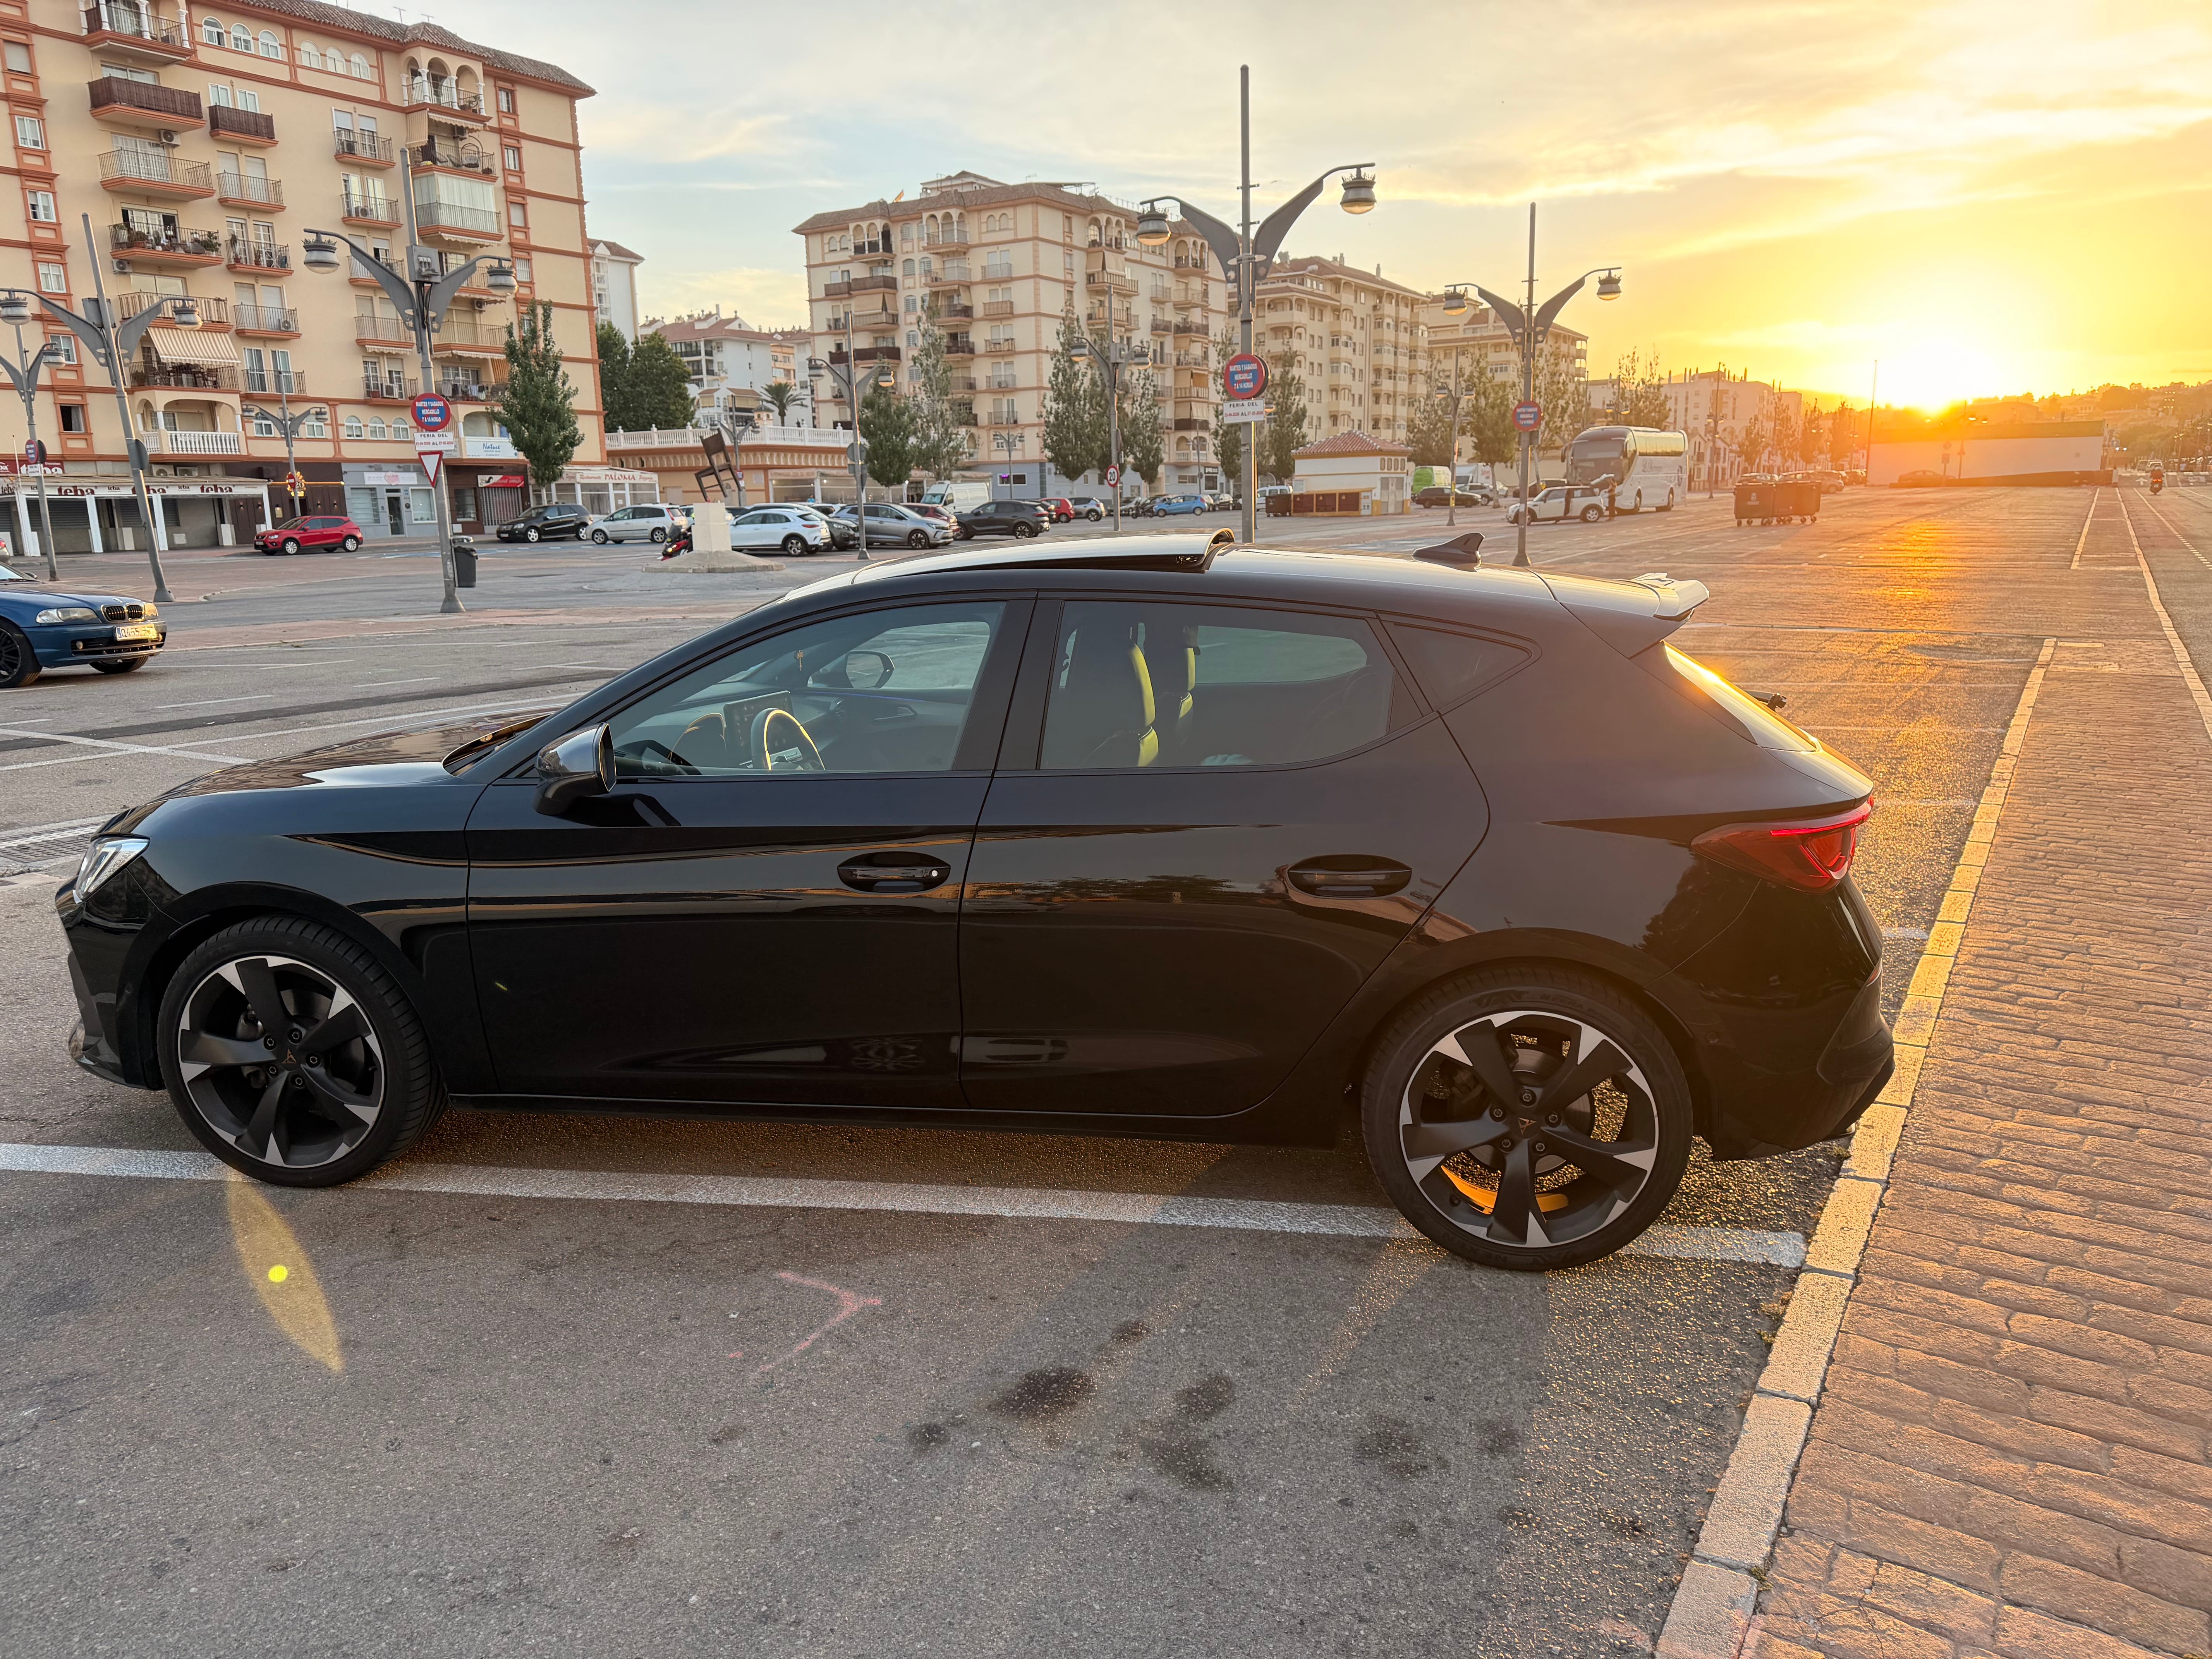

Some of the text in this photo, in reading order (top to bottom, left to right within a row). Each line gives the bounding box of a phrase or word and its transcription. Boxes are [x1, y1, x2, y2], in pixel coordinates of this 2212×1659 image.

[1109, 471, 1115, 481] 20
[57, 485, 95, 496] teba
[200, 484, 233, 493] teba
